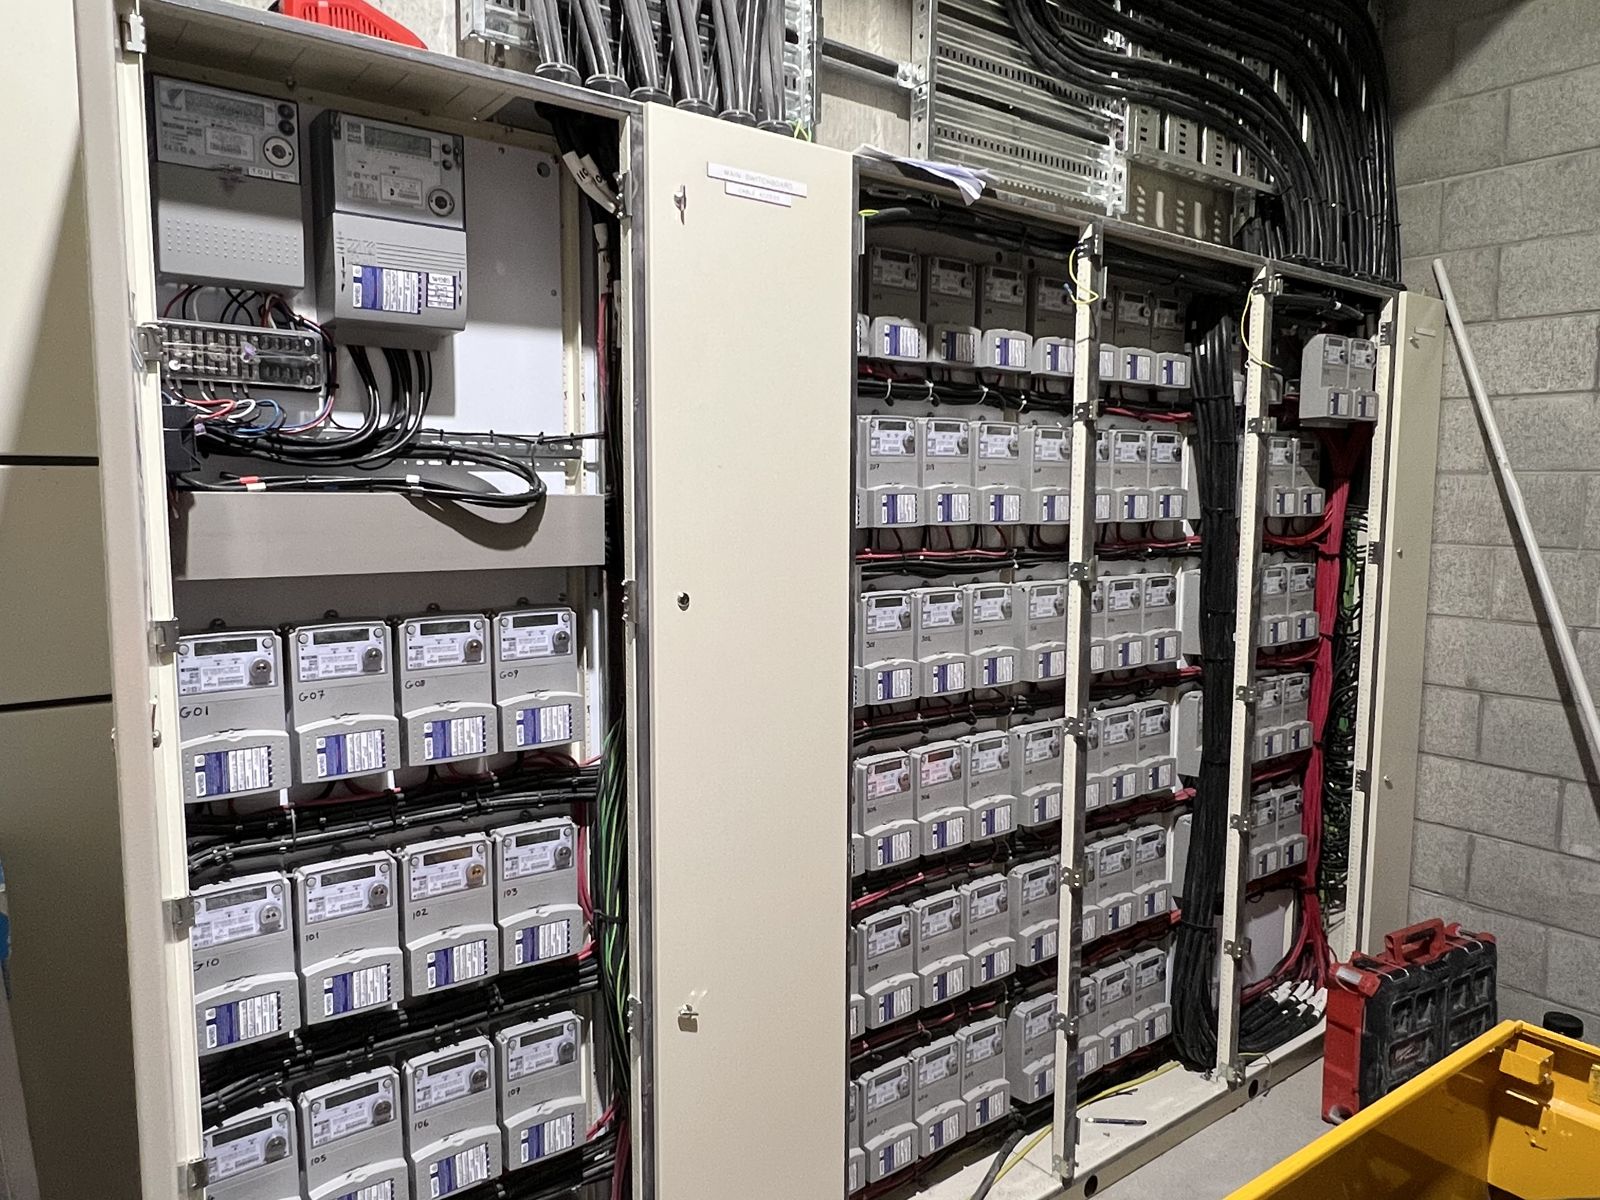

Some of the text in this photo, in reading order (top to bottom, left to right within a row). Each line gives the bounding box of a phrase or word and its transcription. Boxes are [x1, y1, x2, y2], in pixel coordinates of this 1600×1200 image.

[298, 689, 325, 703] G07
[179, 705, 209, 719] G01
[503, 887, 519, 899] 103
[412, 908, 429, 920] 102
[305, 931, 320, 943] 101
[507, 1086, 521, 1098] 107
[414, 1119, 430, 1132] 106
[310, 1154, 327, 1166] 105
